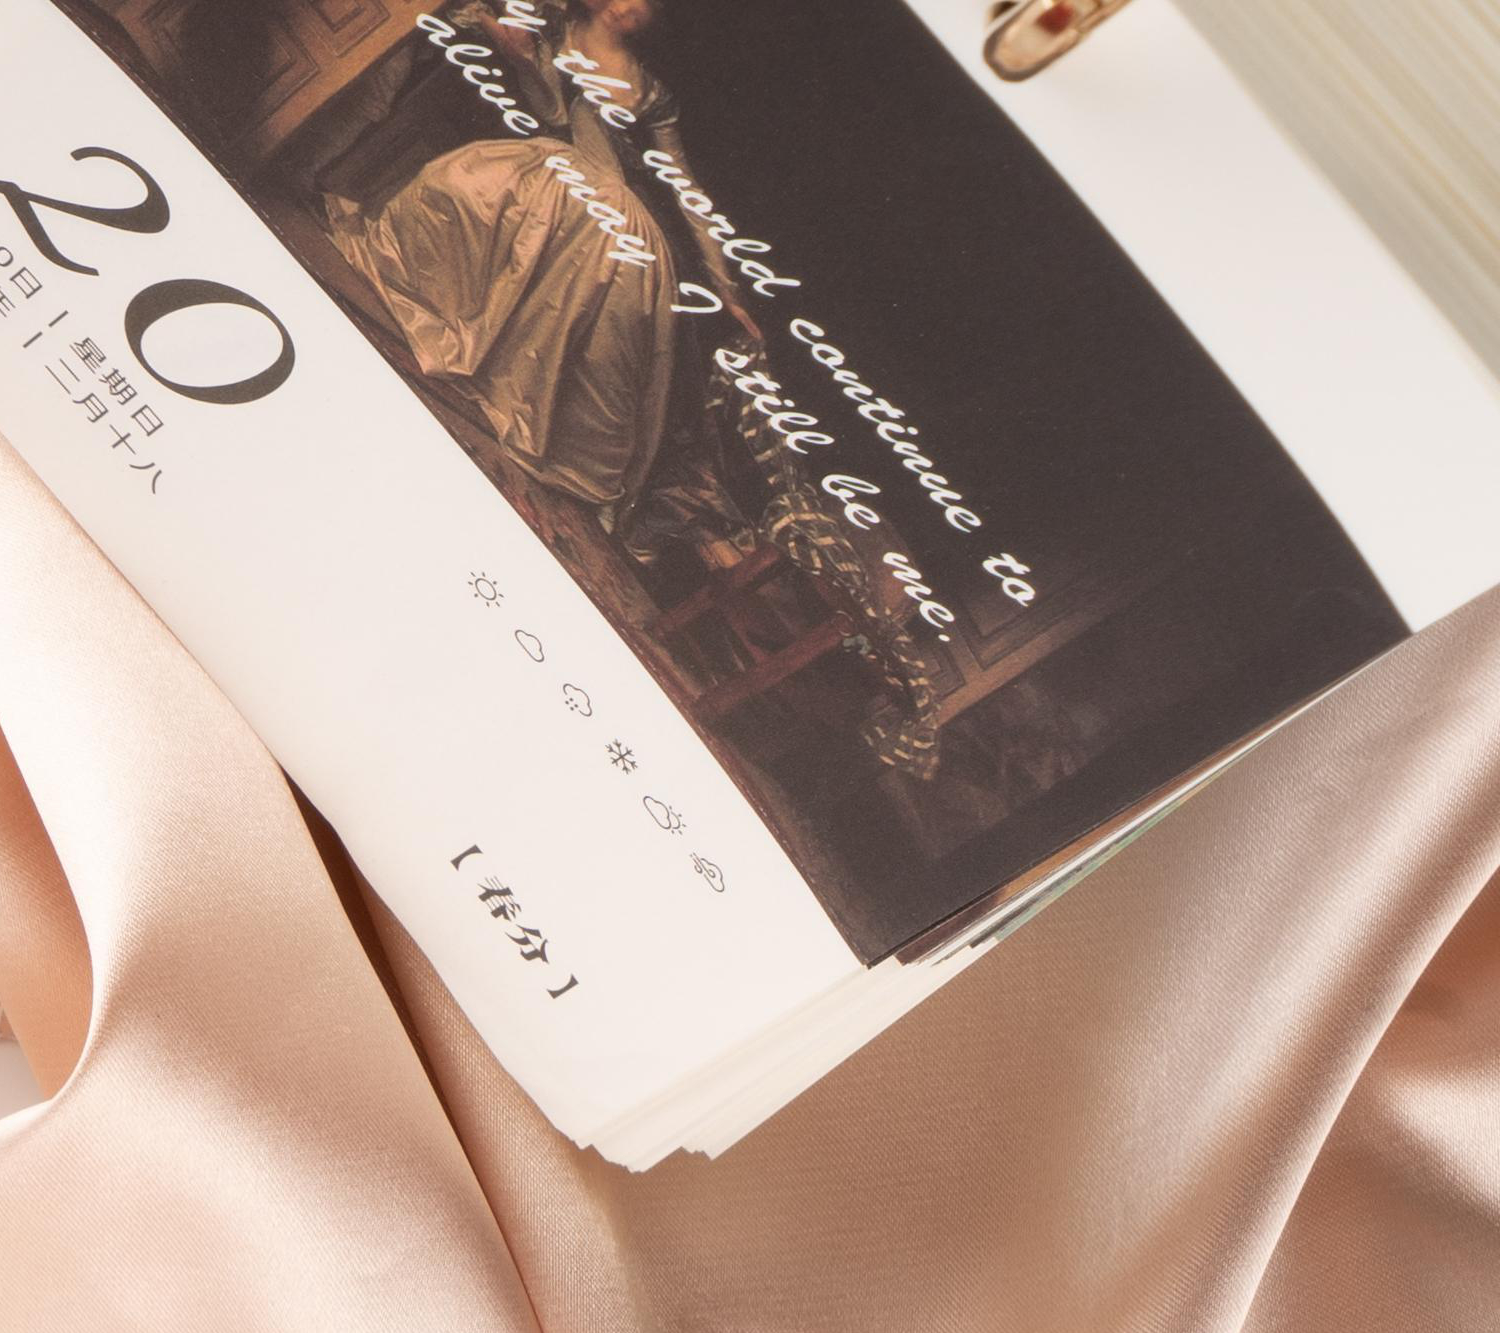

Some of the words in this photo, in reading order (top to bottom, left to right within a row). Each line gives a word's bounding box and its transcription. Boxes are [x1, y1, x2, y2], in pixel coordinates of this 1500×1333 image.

[43, 358, 166, 495] 二月十八
[69, 337, 166, 438] 星期日
[416, 13, 539, 135] alive
[546, 156, 655, 269] may
[716, 348, 832, 454] still
[822, 475, 879, 530] be
[884, 551, 954, 642] me.
[553, 49, 636, 129] the
[643, 149, 801, 297] world
[791, 318, 981, 532] continue
[982, 553, 1035, 607] to
